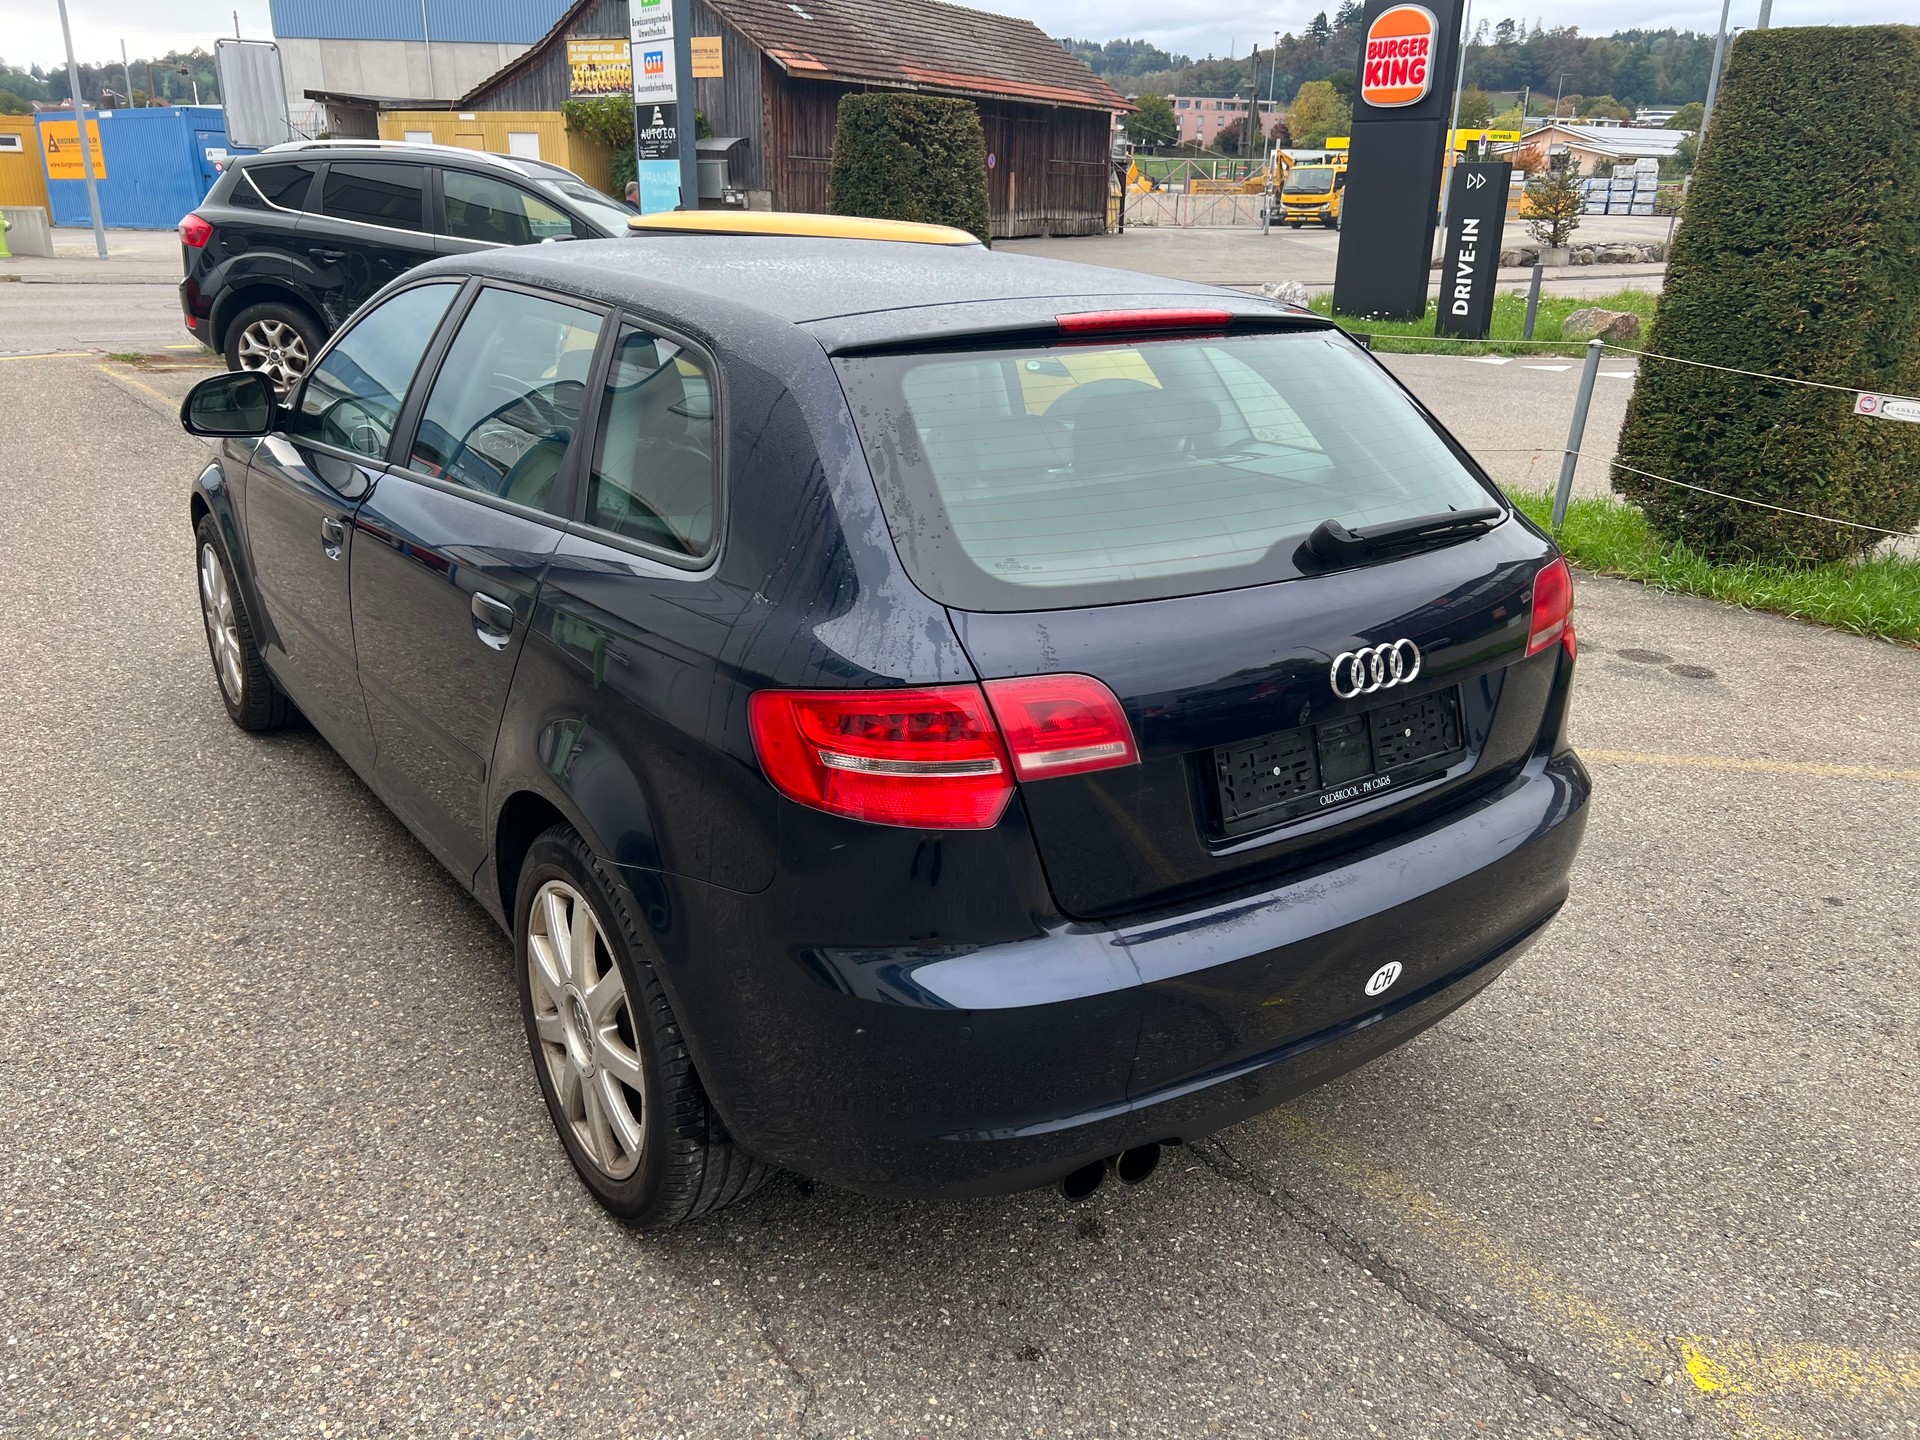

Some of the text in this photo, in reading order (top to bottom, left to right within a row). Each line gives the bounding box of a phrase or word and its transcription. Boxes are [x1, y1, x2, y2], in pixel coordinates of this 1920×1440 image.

[1367, 37, 1429, 60] BURGER
[645, 55, 661, 70] OTT
[1365, 58, 1426, 87] KING
[1491, 132, 1511, 140] carwash
[1452, 218, 1480, 316] DRIVE-IN
[1319, 786, 1359, 806] OLDSKOOL
[1372, 774, 1391, 789] CARS
[1372, 965, 1396, 991] CH
